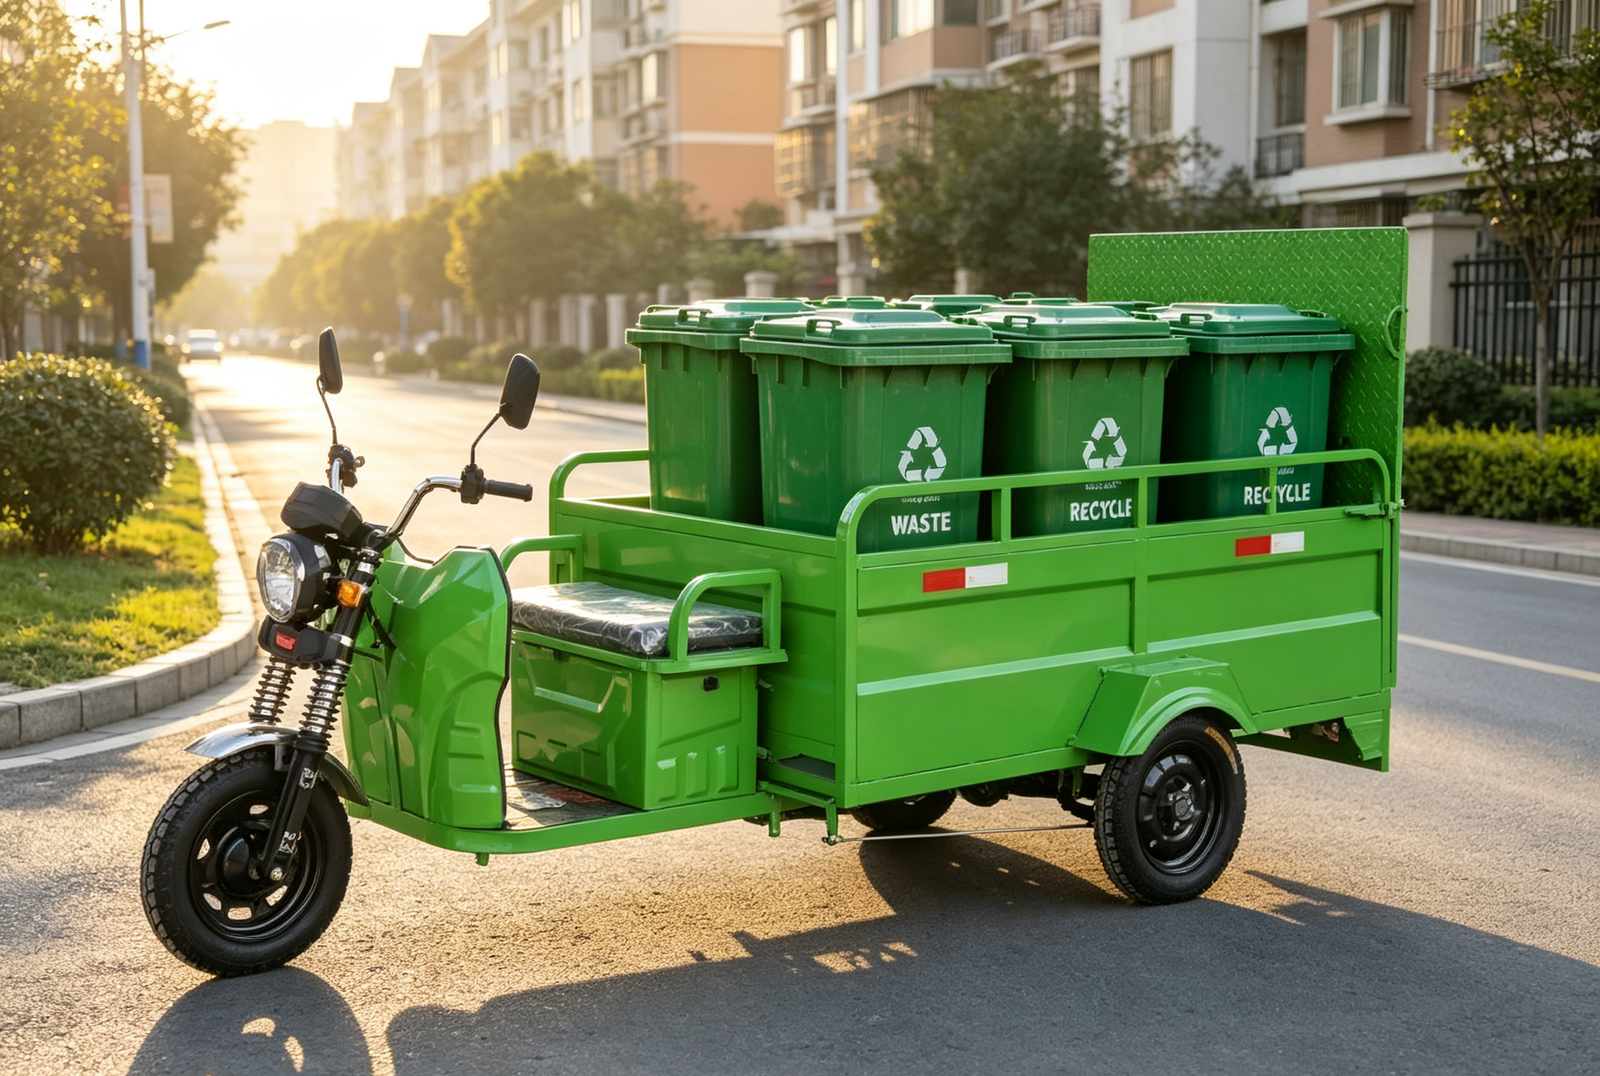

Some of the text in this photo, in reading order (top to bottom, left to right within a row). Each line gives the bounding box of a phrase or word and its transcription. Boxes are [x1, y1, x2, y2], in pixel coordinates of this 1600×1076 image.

[1244, 483, 1311, 505] RECYCLE
[1070, 498, 1132, 521] RECYCLE
[891, 511, 951, 536] WASTE
